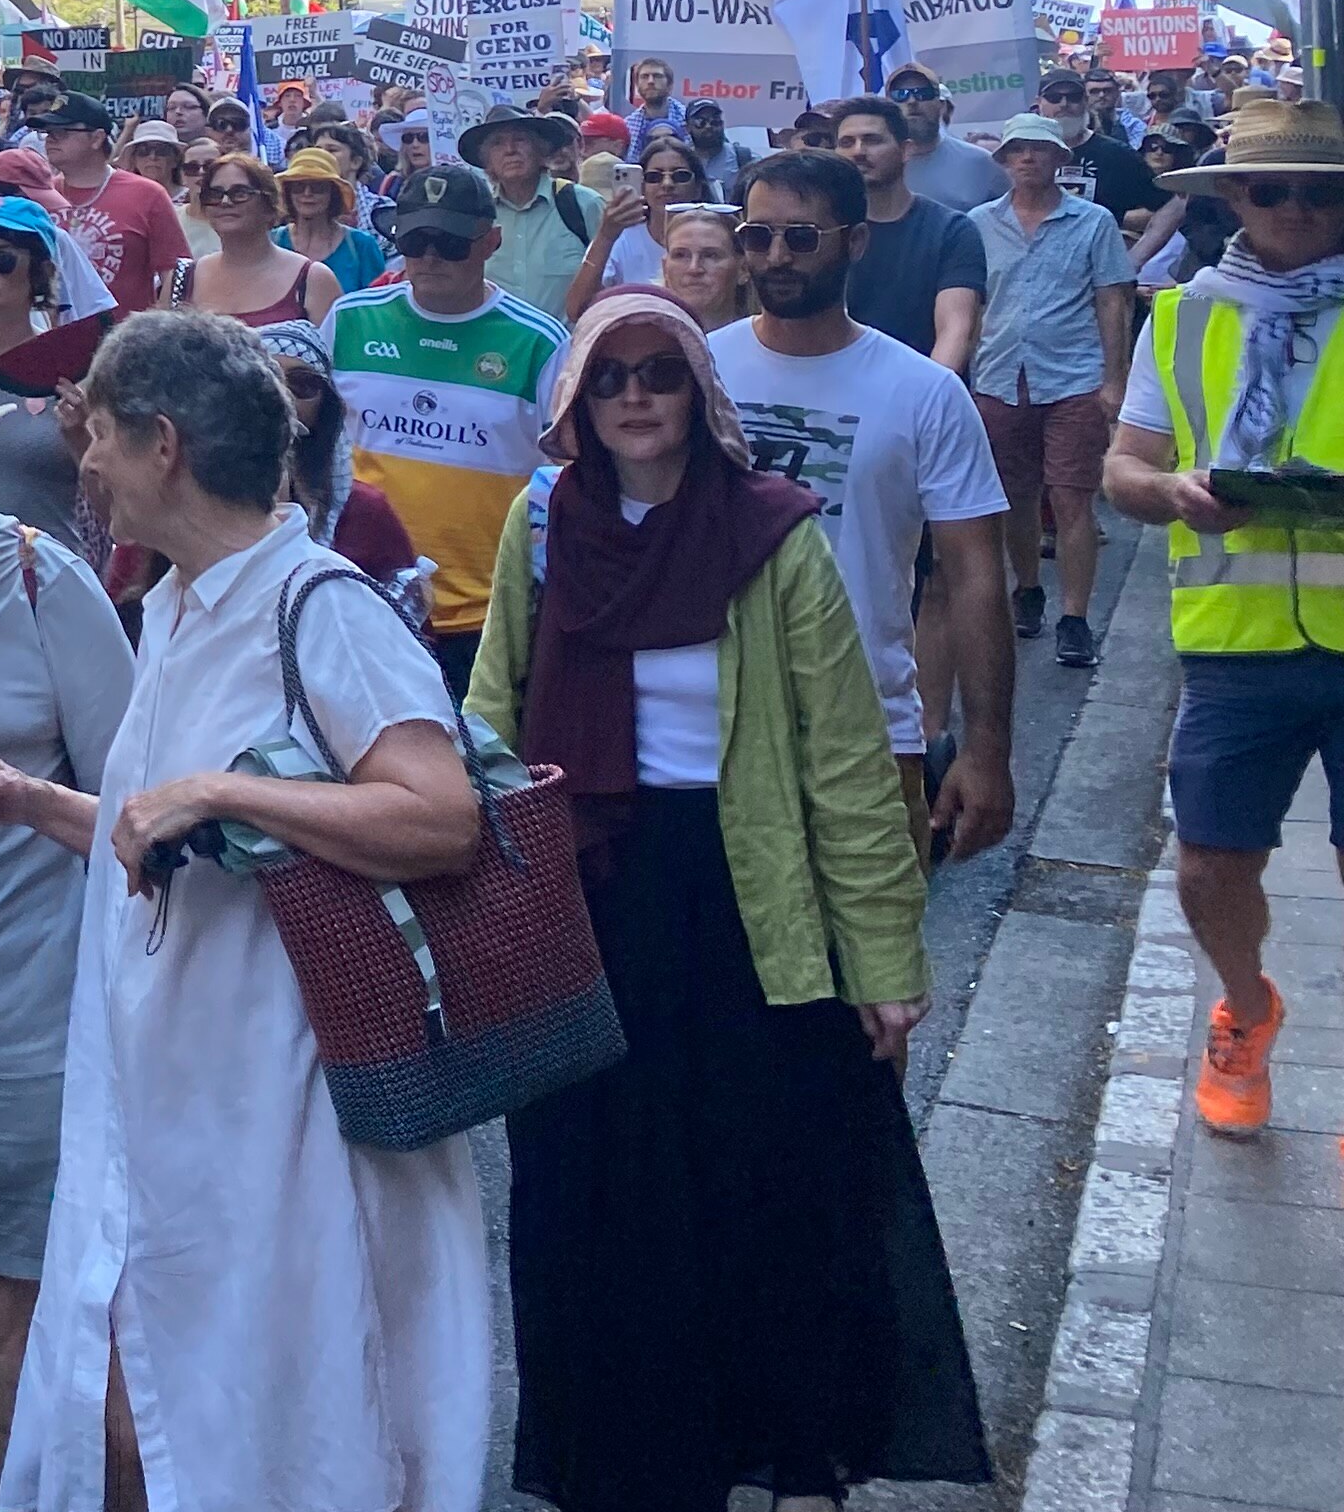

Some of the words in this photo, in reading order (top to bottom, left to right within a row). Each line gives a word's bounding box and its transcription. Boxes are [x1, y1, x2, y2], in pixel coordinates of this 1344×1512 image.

[1041, 0, 1073, 15] Pride
[1076, 6, 1089, 16] in
[285, 16, 319, 30] FREE
[407, 16, 468, 38] ARMING
[490, 20, 529, 36] FOR
[1033, 10, 1086, 29] enocide
[1103, 15, 1198, 36] SANCTIONS
[42, 32, 64, 48] NO
[69, 29, 107, 49] PRIDE
[141, 32, 184, 49] CUT
[266, 29, 341, 47] PALESTINE
[399, 31, 431, 50] END
[475, 33, 553, 55] GENO
[1123, 35, 1179, 56] NOW!
[83, 52, 102, 69] IN
[272, 49, 338, 66] BOYCOTT
[372, 46, 404, 63] THE
[281, 64, 331, 79] ISRAEL
[370, 66, 393, 82] ON
[395, 74, 425, 90] GAZ
[472, 73, 551, 90] REVENG
[682, 78, 761, 99] Labor
[940, 71, 1024, 95] estine
[364, 341, 400, 359] GAA
[361, 409, 488, 447] CARROLL'S
